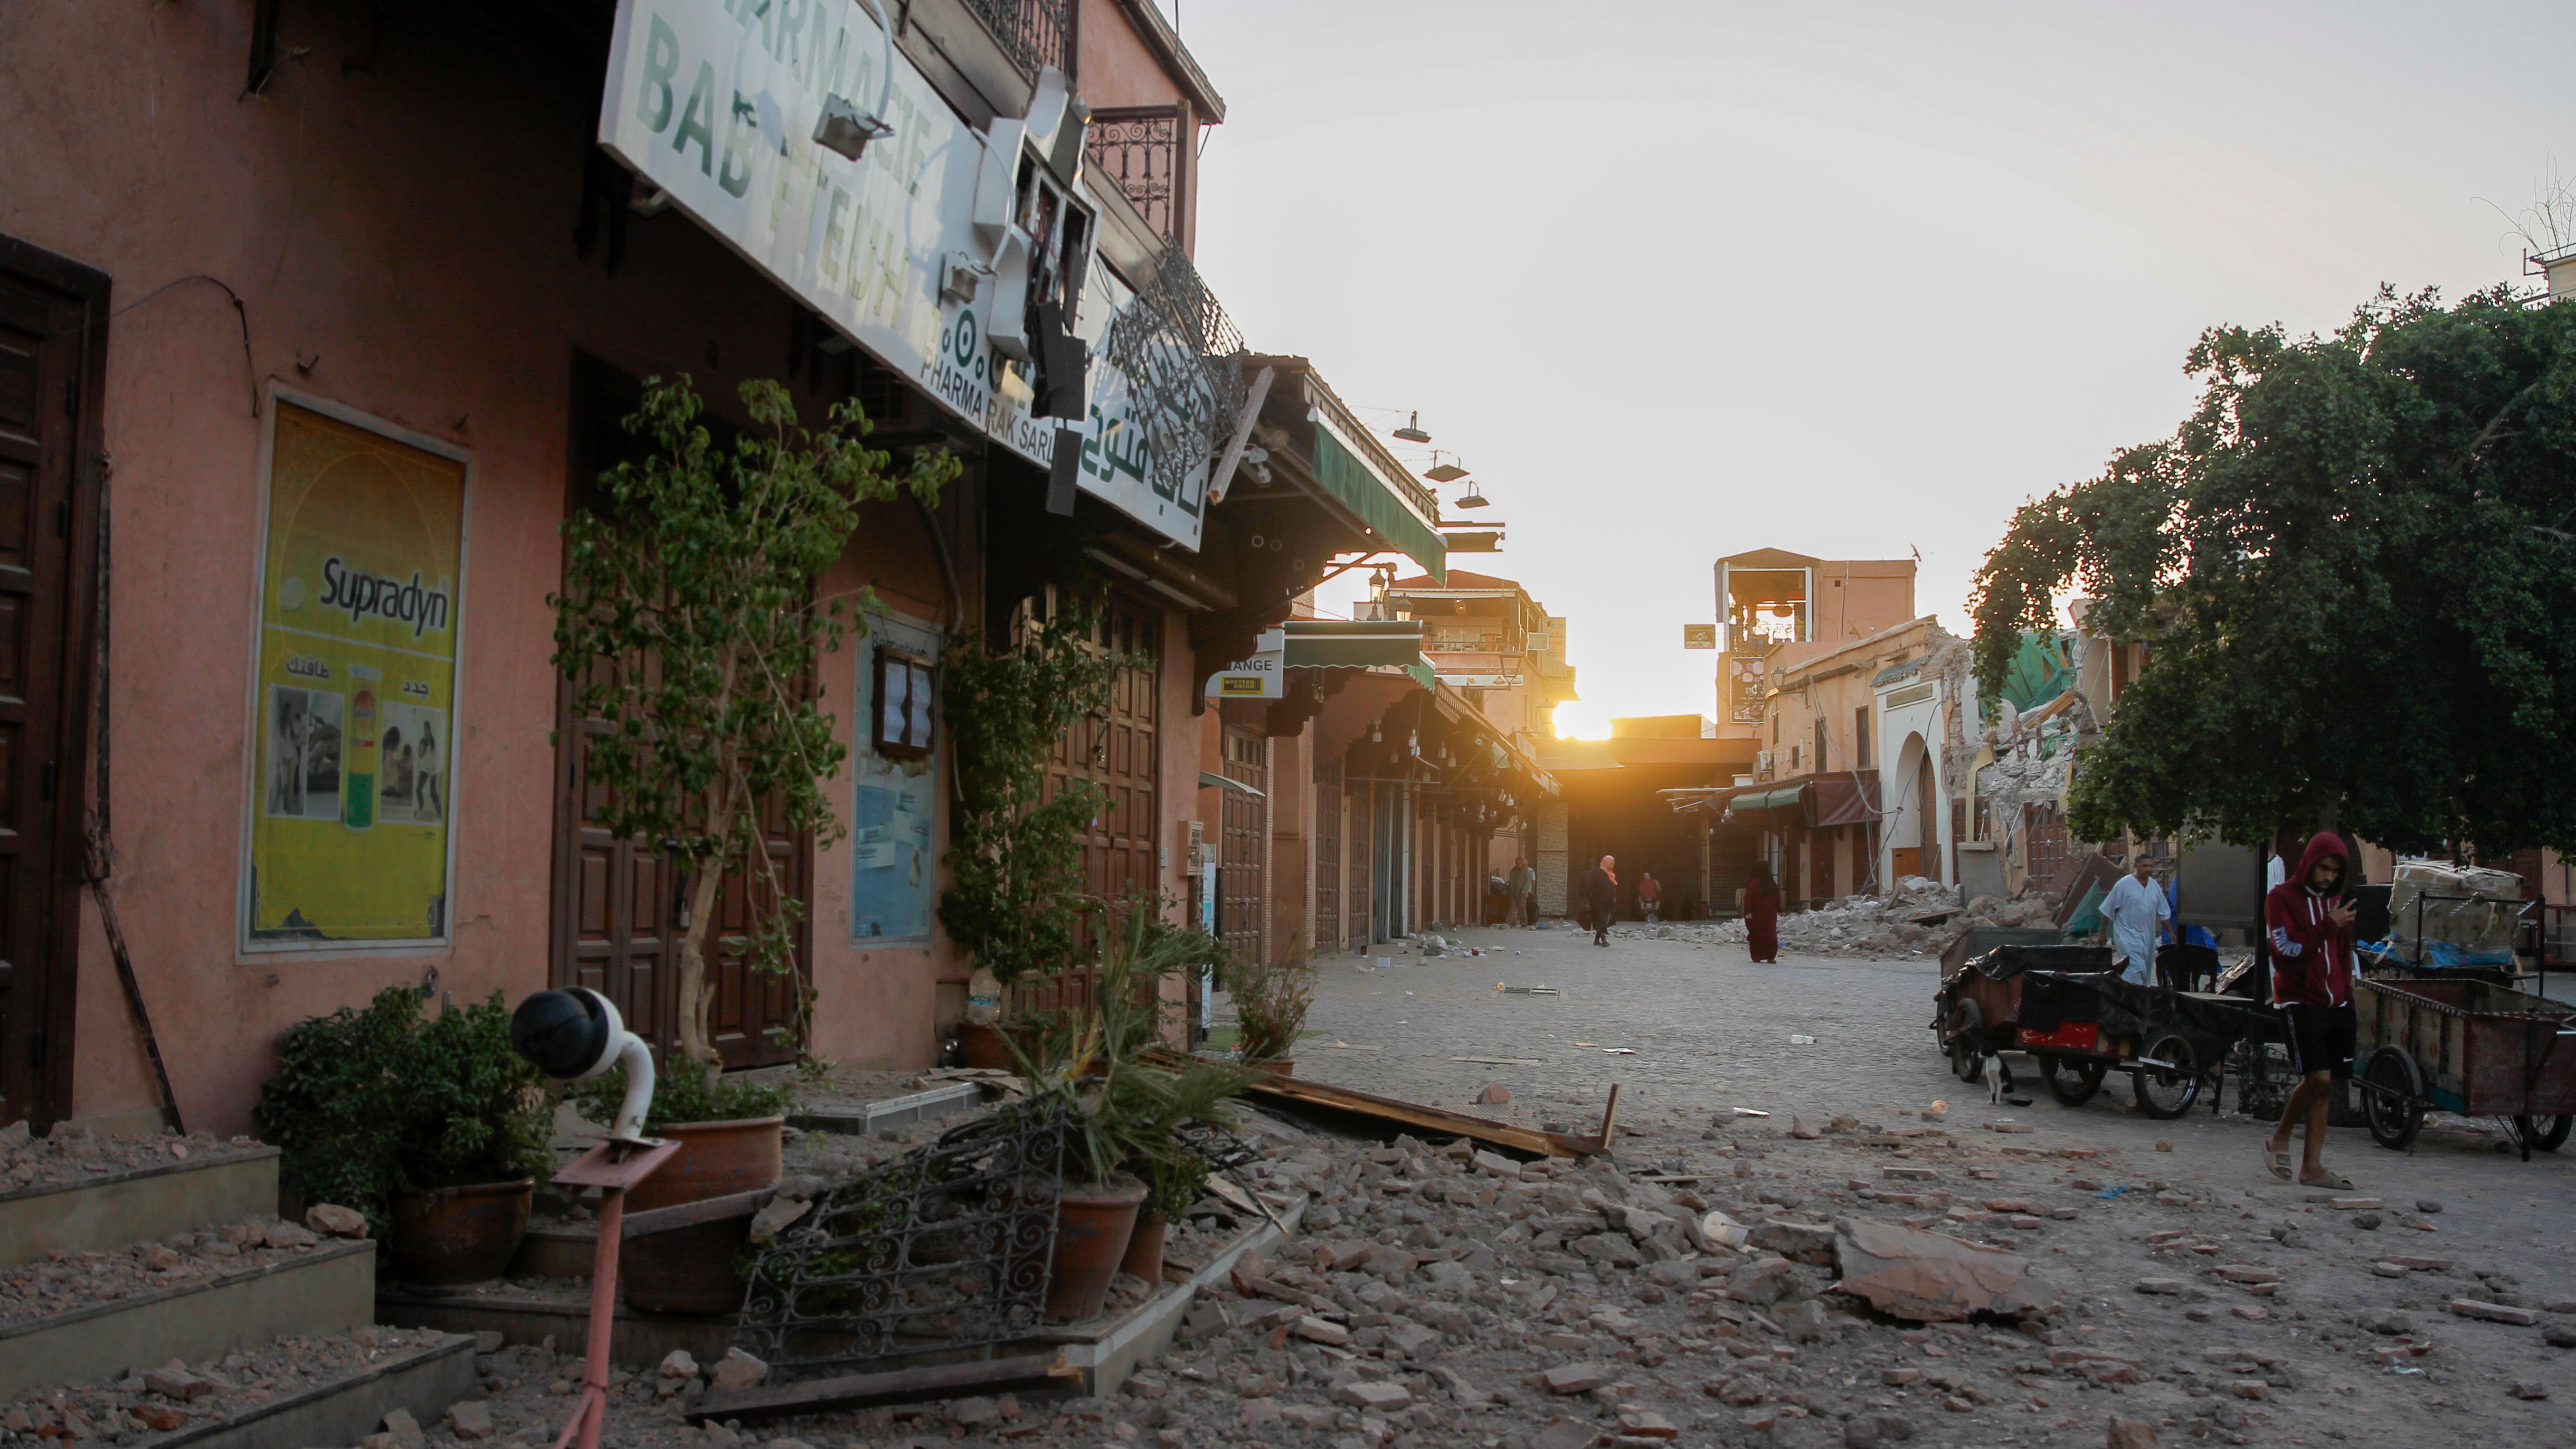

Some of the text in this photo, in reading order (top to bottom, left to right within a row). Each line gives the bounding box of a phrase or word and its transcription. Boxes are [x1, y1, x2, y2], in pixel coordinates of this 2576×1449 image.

[636, 12, 759, 200] BAB
[724, 0, 931, 201] ARMACIE
[921, 346, 1053, 465] PHARMA RAK SARL
[320, 557, 448, 637] Supradyn
[286, 656, 429, 699] جدد طاقتك
